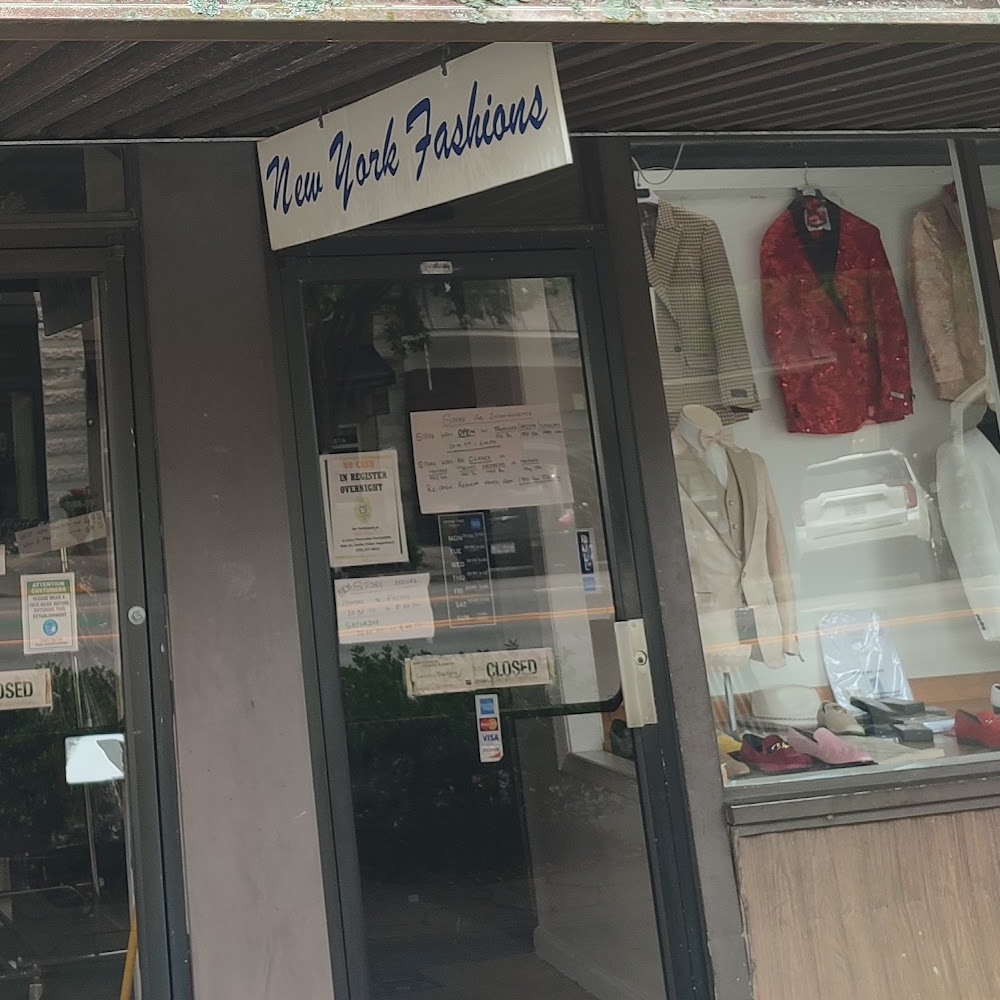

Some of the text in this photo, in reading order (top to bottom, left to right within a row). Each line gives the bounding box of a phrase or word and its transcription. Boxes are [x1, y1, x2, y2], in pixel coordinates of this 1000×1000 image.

[266, 80, 550, 215] New York Fashions
[457, 428, 475, 437] OPEN
[342, 459, 375, 469] NO CASH
[339, 470, 388, 482] IN REGISTER
[339, 482, 383, 494] OVERNIGHT
[31, 580, 65, 588] ATTENTION
[352, 580, 384, 592] STORE
[30, 586, 67, 594] CUSTOMERS
[486, 658, 538, 679] CLOSED
[482, 733, 500, 742] VISA
